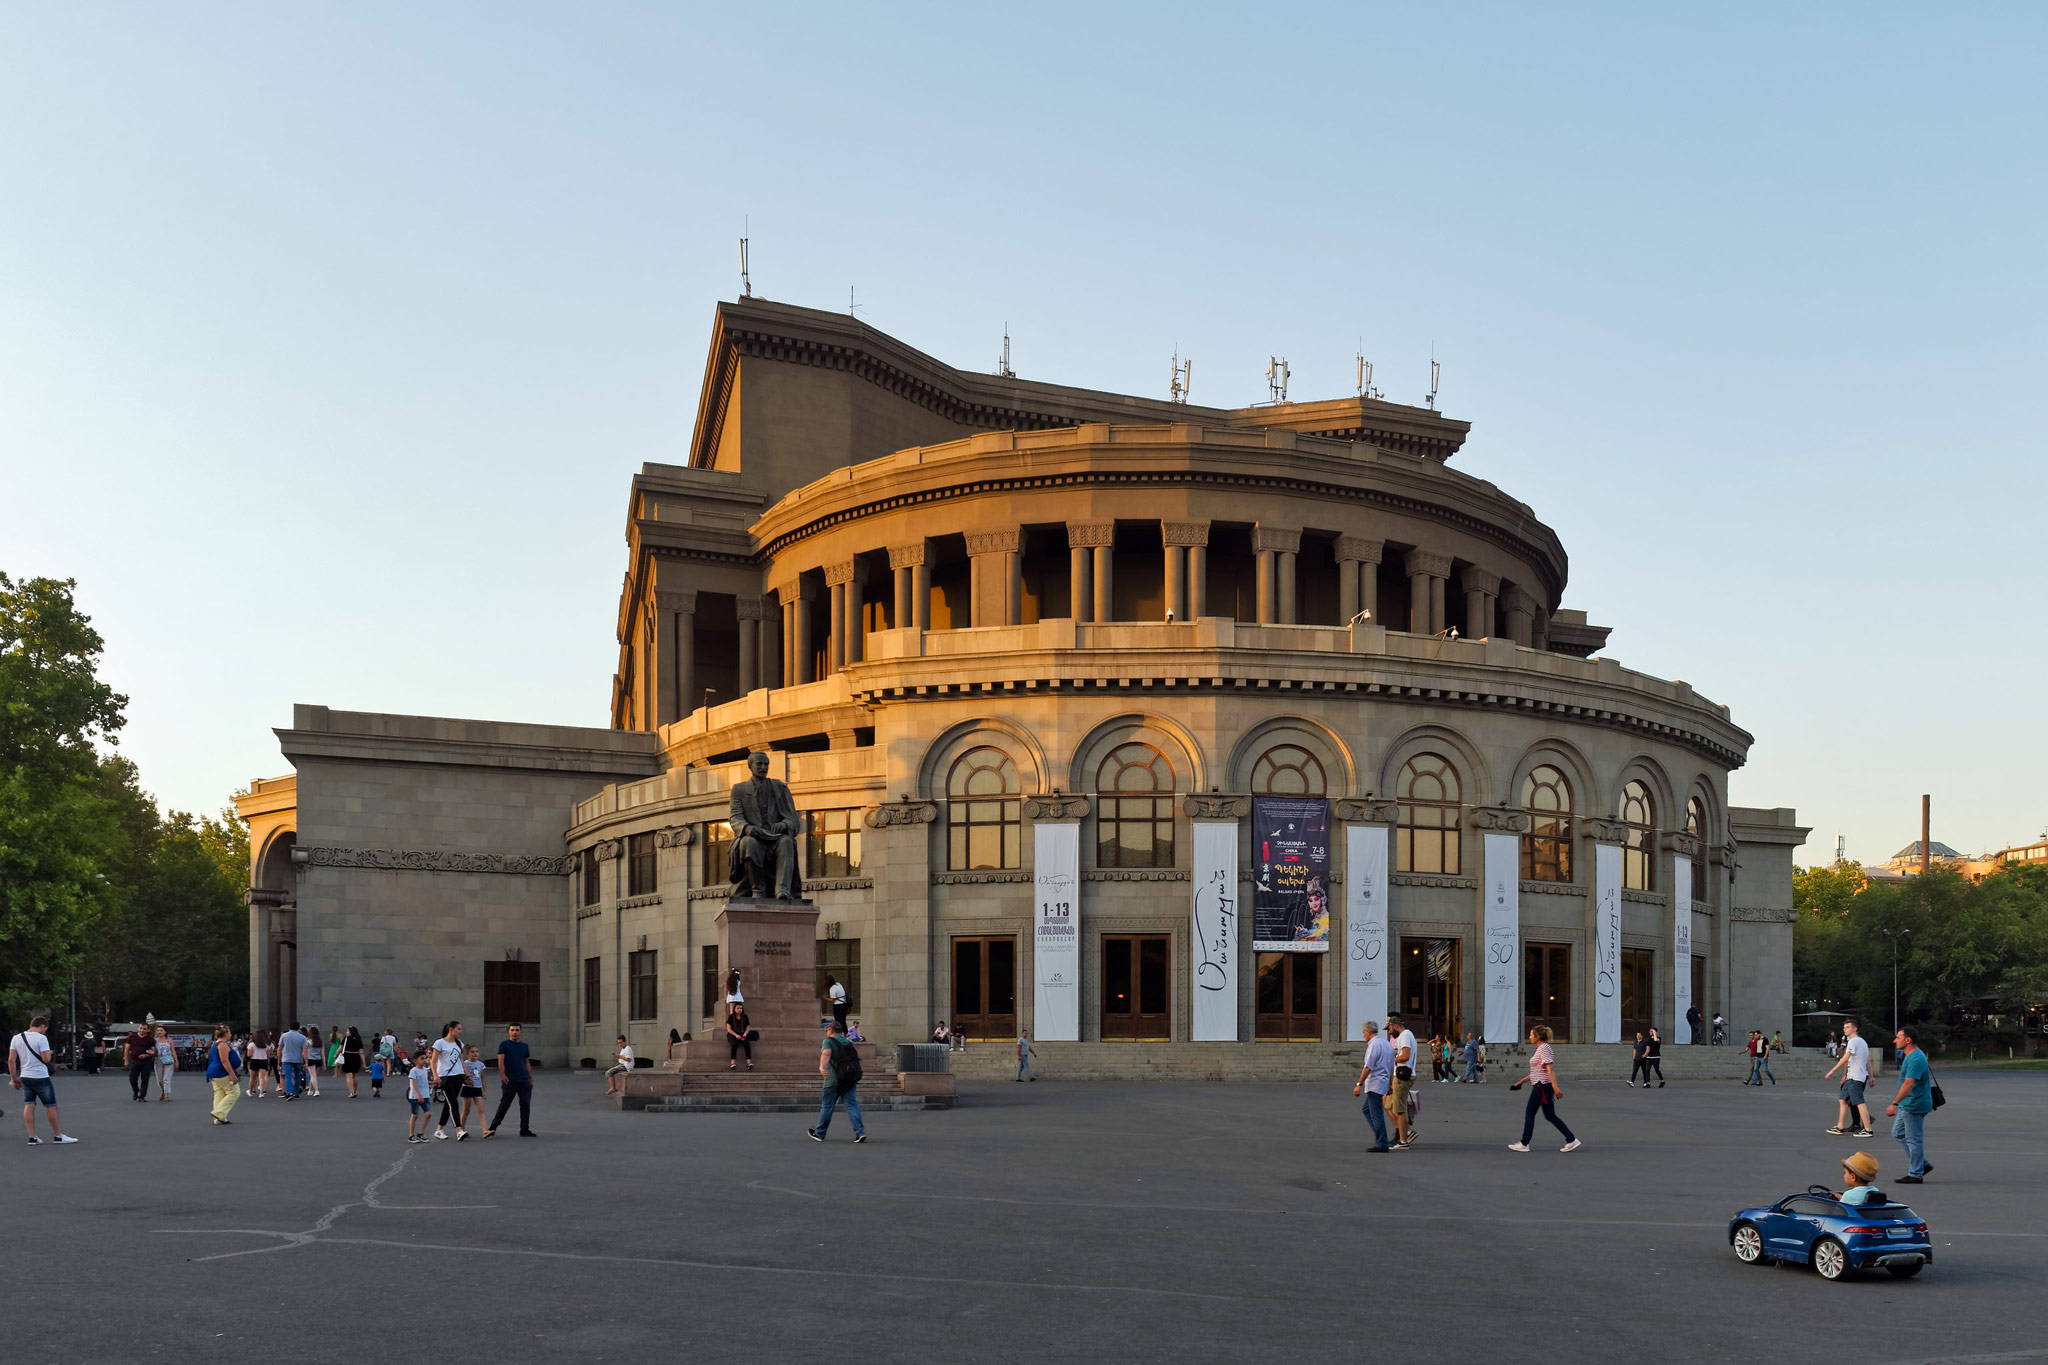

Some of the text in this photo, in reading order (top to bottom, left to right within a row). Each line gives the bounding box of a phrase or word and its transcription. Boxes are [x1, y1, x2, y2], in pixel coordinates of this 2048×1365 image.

[1274, 864, 1309, 876] Պեկինի
[1043, 902, 1069, 917] 1-13
[1351, 938, 1381, 960] 80
[1488, 942, 1513, 965] 80
